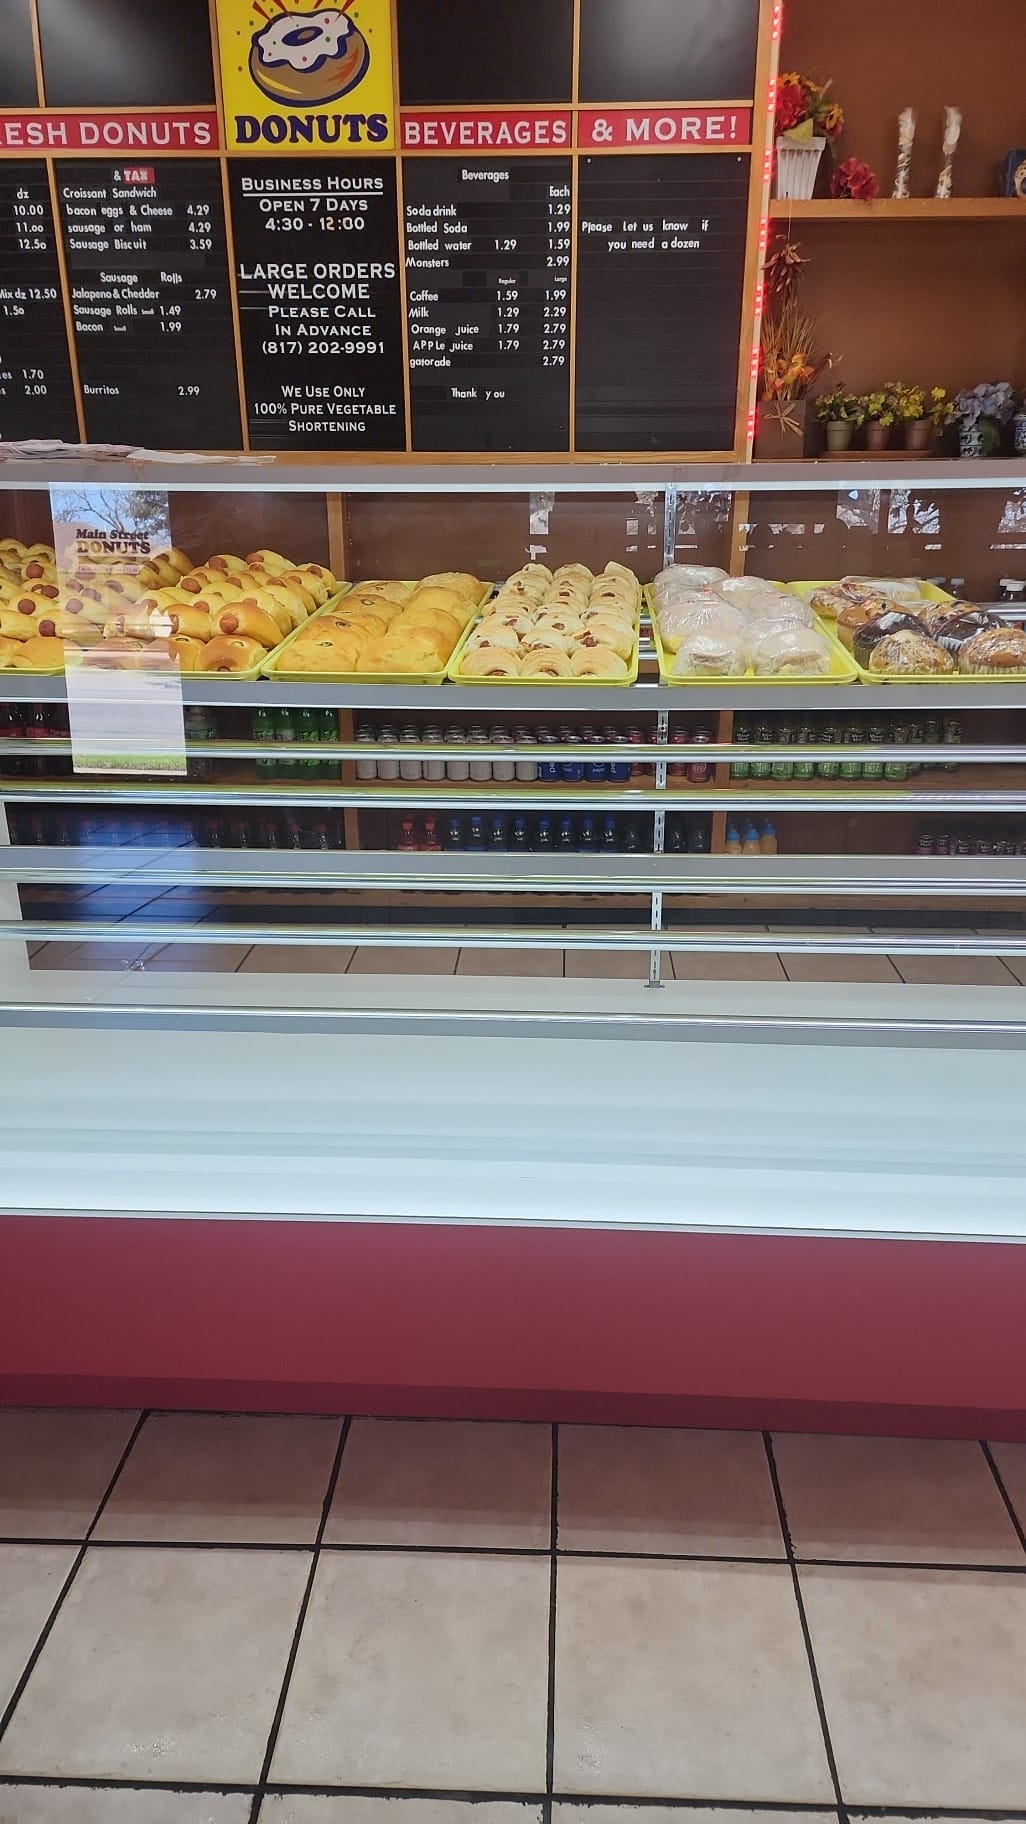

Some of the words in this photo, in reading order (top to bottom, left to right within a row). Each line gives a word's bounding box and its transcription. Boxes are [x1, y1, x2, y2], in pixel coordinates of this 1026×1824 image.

[0, 122, 67, 145] ESH
[79, 122, 211, 145] DONUTS
[235, 114, 388, 144] DONUTS
[404, 120, 567, 145] BEVERAGES
[592, 118, 613, 142] &
[626, 116, 737, 141] MORE!
[113, 170, 122, 181] &
[461, 169, 510, 183] Beverages
[17, 188, 30, 199] dz
[63, 187, 107, 199] Croissant
[112, 187, 157, 199] Sandwich
[549, 185, 570, 198] Each
[13, 205, 44, 216] 10.00
[66, 204, 97, 216] bacon
[101, 206, 124, 218] eggs
[129, 205, 138, 216] &
[140, 205, 173, 216] Cheese
[186, 205, 210, 216] 4.29
[310, 199, 321, 212] 7
[406, 205, 432, 217] Soda
[433, 204, 457, 217] drink
[548, 204, 571, 215] 1.29
[67, 223, 106, 236] sausage
[114, 224, 125, 233] or
[131, 222, 152, 233] ham
[188, 222, 212, 233] 4.29
[265, 217, 304, 231] 4:30
[406, 222, 437, 233] Bottled
[443, 222, 468, 233] Soda
[548, 221, 570, 232] 1.99
[582, 221, 613, 234] Please
[643, 222, 654, 231] us
[662, 219, 689, 231] know
[701, 220, 710, 231] if
[69, 239, 109, 251] Sausage
[114, 239, 147, 250] Biscuit
[190, 239, 213, 250] 3.59
[408, 239, 439, 251] Bottled
[444, 240, 472, 251] water
[494, 239, 517, 250] 1.29
[548, 239, 571, 250] 1.59
[608, 240, 627, 252] you
[631, 237, 655, 249] need
[661, 240, 668, 249] a
[671, 236, 700, 249] dozen
[405, 256, 450, 269] Monsters
[546, 256, 569, 267] 2.99
[240, 263, 308, 280] LARGE
[313, 263, 396, 280] ORDERS
[100, 272, 139, 285] Sausage
[160, 272, 183, 284] Rolls
[15, 288, 27, 299] dz
[29, 288, 57, 299] 12.50
[195, 289, 217, 300] 2.79
[267, 283, 370, 299] WELCOME
[409, 289, 439, 301] Coffee
[496, 290, 519, 301] 1.59
[545, 289, 567, 301] 1.99
[73, 304, 112, 316] Sausage
[116, 304, 138, 315] Rolls
[160, 305, 181, 316] 1.49
[408, 306, 430, 318] Milk
[497, 307, 520, 318] 1.29
[543, 306, 567, 317] 2.29
[76, 321, 104, 332] Bacon
[160, 322, 182, 332] 1.99
[410, 324, 447, 336] Orange
[498, 323, 520, 334] 1.79
[543, 323, 567, 334] 2.79
[262, 340, 303, 355] (817)
[307, 341, 385, 354] 202-9991
[498, 340, 520, 350] 1.79
[542, 340, 566, 350] 2.79
[409, 356, 451, 369] gatorade
[542, 356, 565, 366] 2.79
[22, 369, 44, 380] 1.70
[24, 385, 47, 395] 2.00
[84, 384, 120, 395] Burritos
[178, 386, 200, 396] 2.99
[450, 387, 477, 399] Thank
[254, 402, 288, 415] 100%
[75, 529, 107, 540] Main
[109, 529, 149, 540] Street
[77, 541, 151, 555] DONUTS
